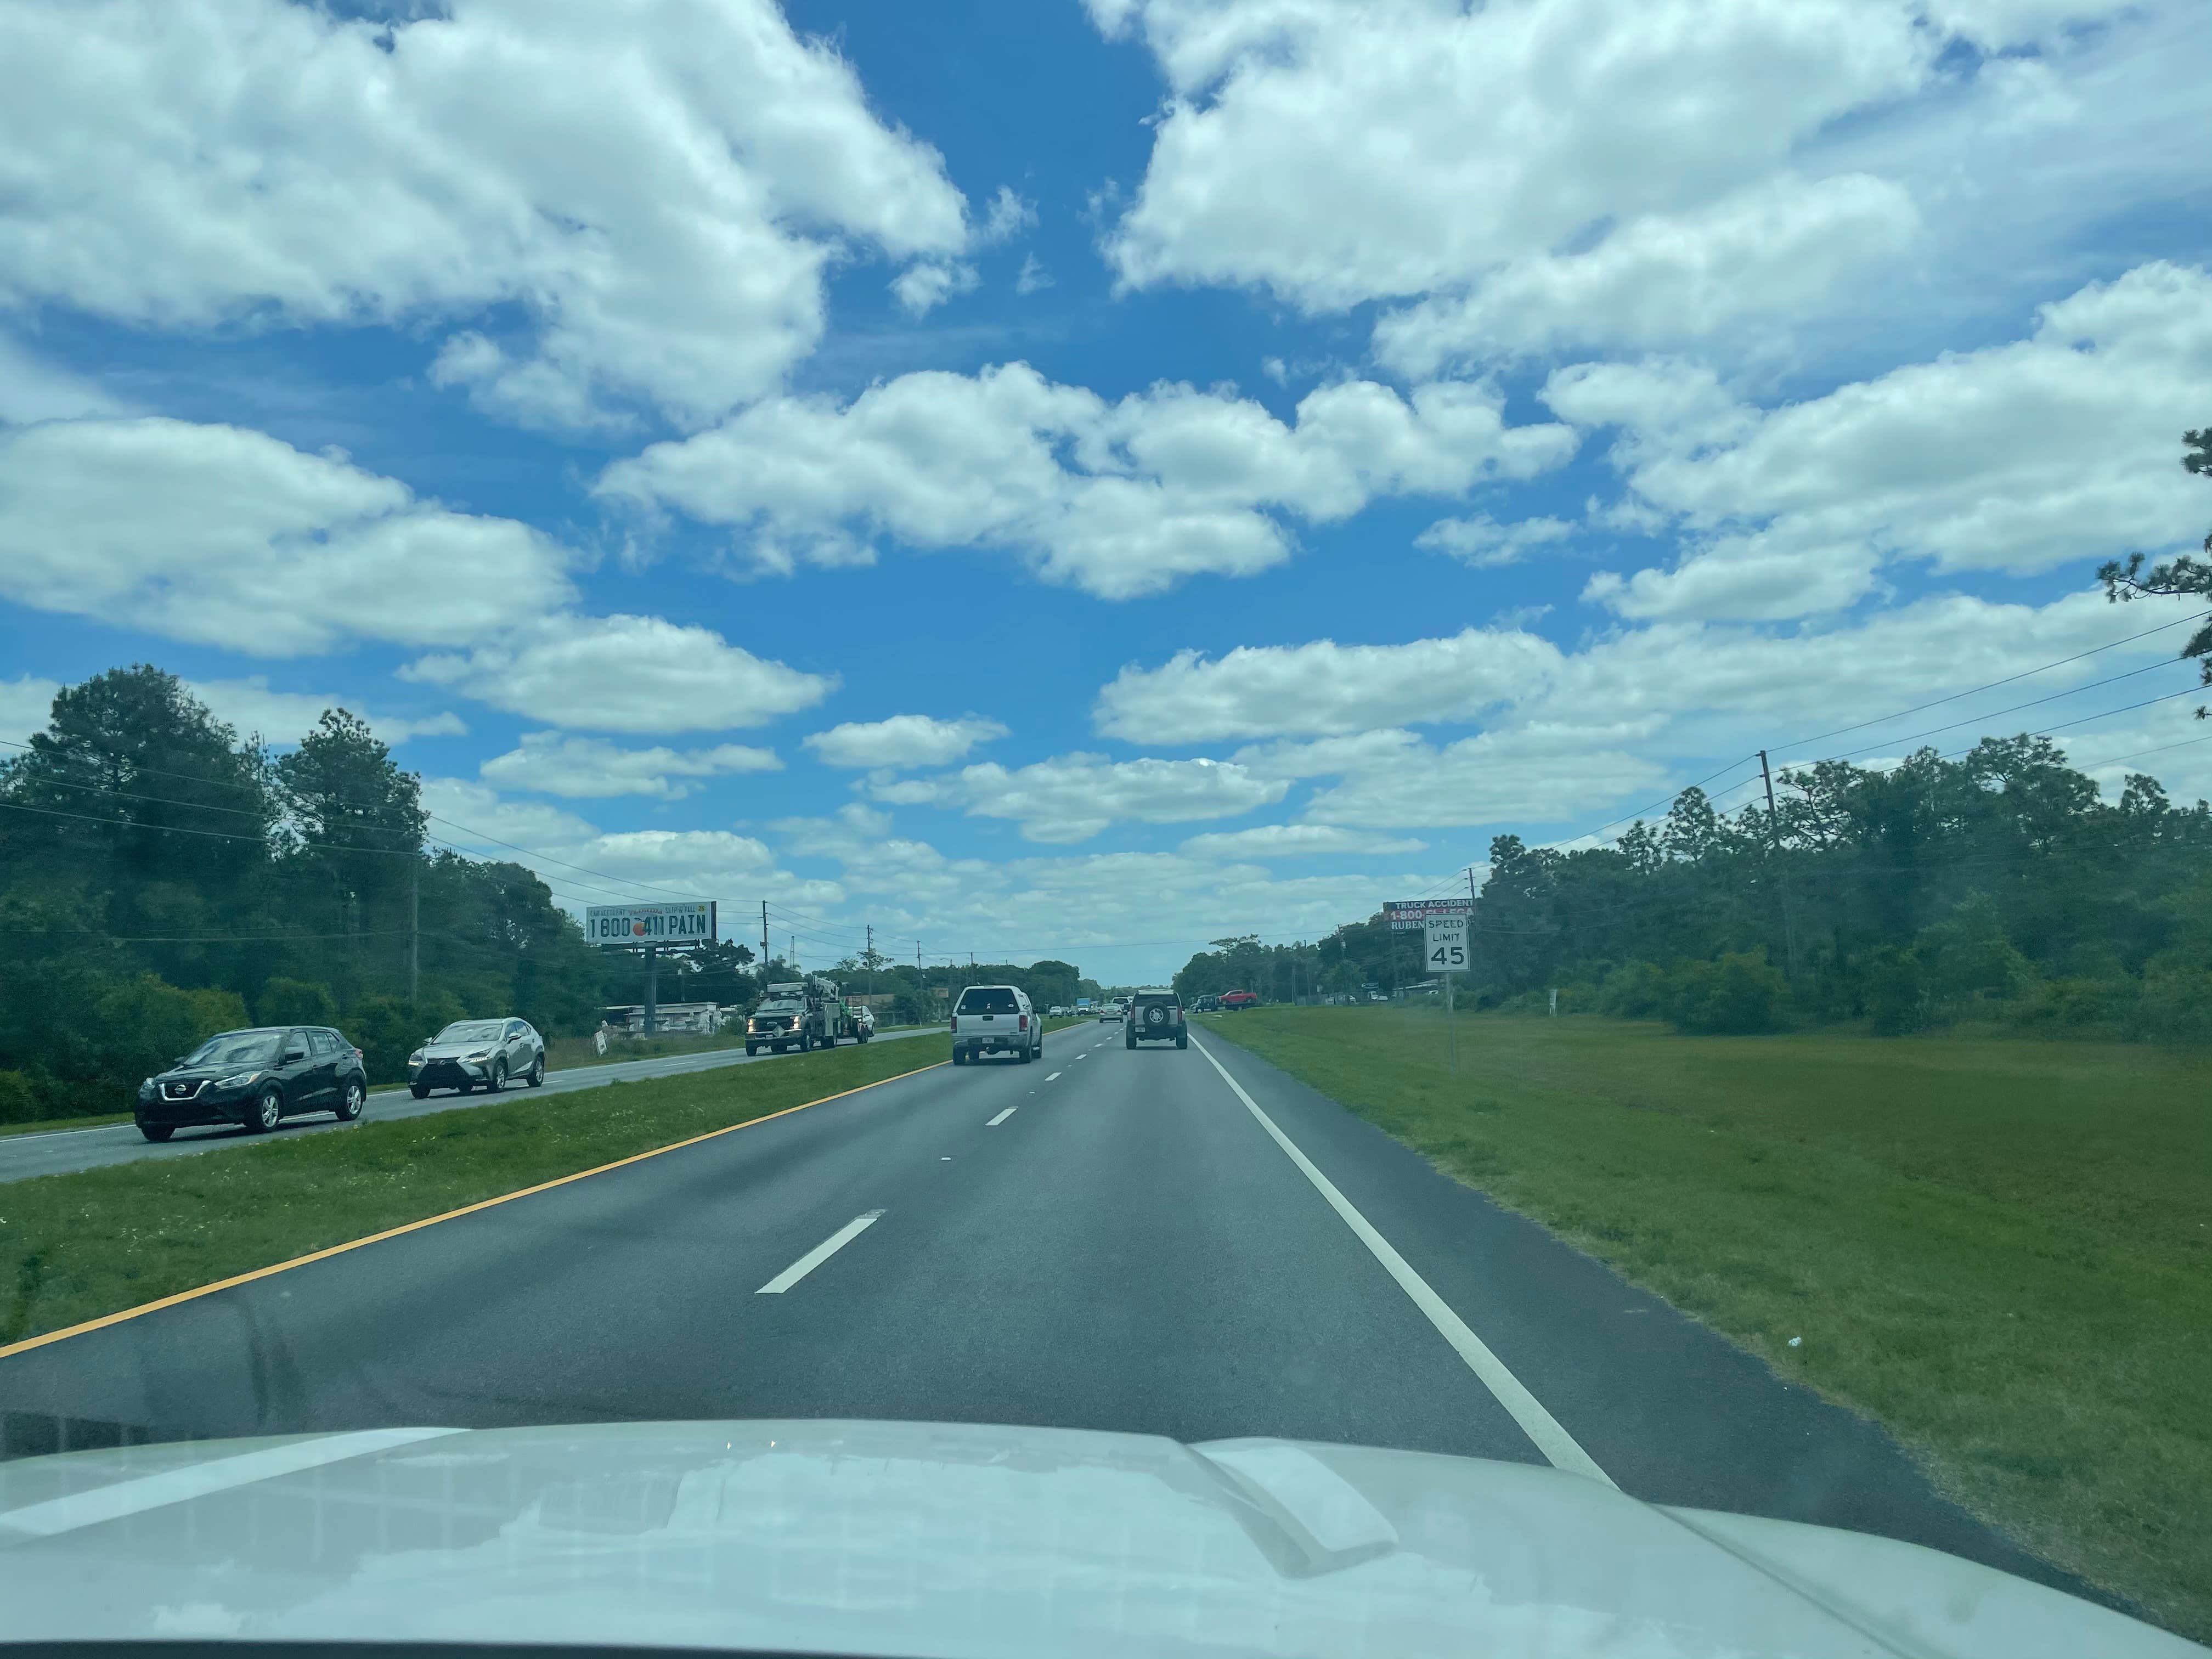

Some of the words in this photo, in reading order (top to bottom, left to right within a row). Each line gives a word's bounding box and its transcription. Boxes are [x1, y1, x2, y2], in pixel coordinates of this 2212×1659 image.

[1428, 900, 1473, 908] ACCIDENT
[590, 919, 595, 938] 1
[601, 918, 630, 937] 800
[644, 916, 664, 935] 411
[669, 915, 706, 934] PAIN
[1429, 919, 1464, 928] SPEED
[1433, 933, 1459, 942] LIMIT
[1431, 947, 1464, 964] 45
